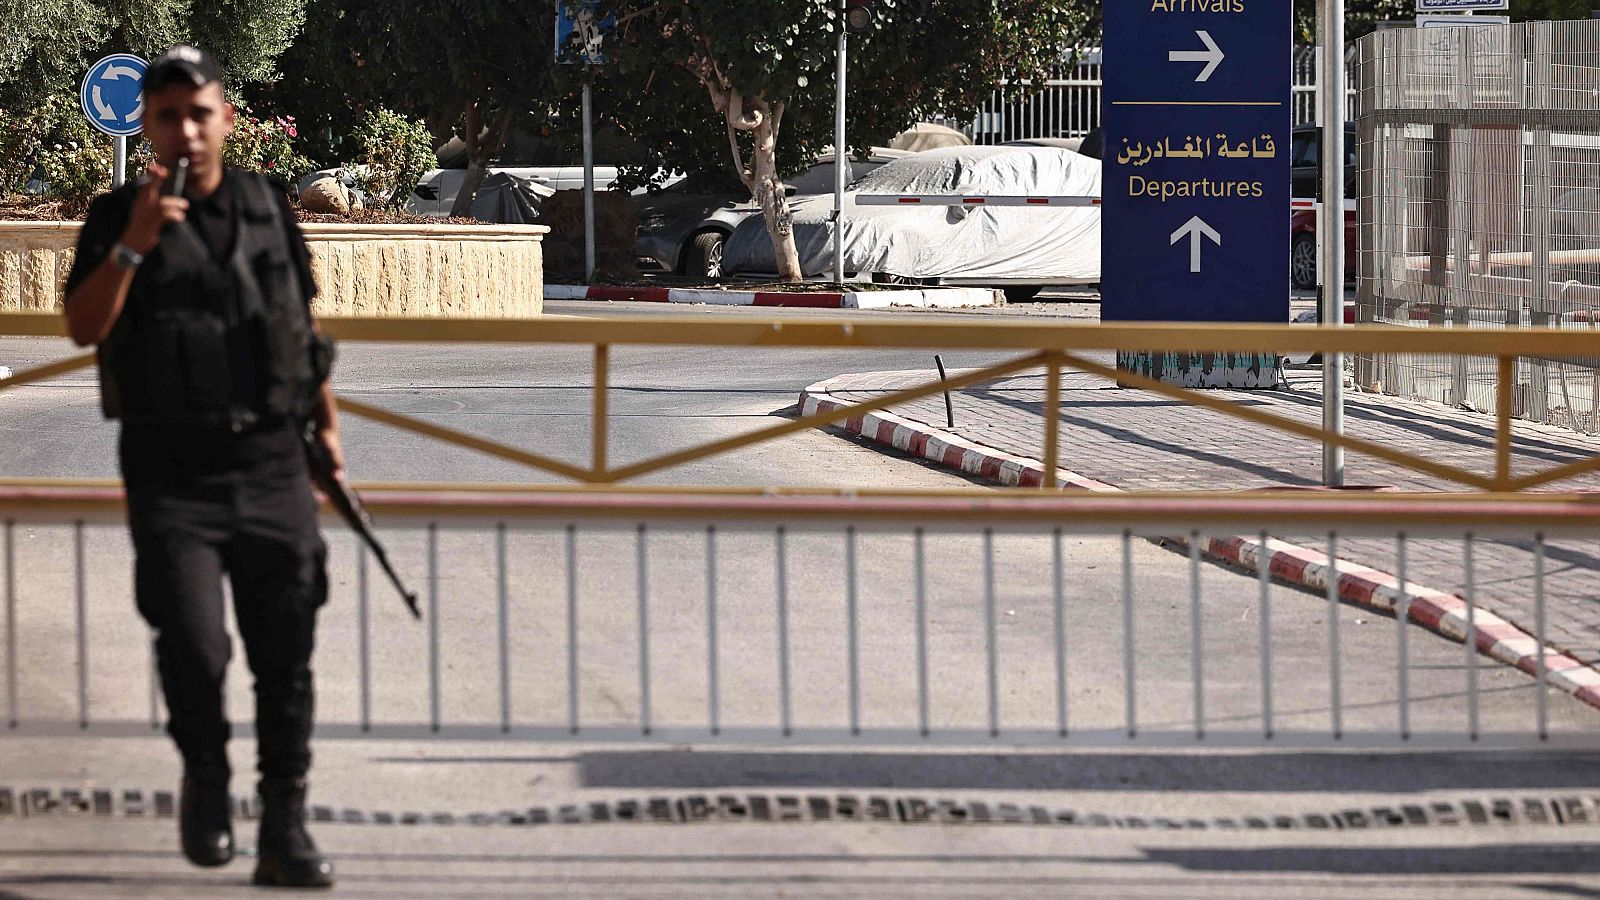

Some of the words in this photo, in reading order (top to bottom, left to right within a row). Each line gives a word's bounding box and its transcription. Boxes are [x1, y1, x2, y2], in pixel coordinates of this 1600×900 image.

[1151, 0, 1244, 12] Arrivals
[1117, 135, 1211, 166] المغادرين
[1216, 133, 1276, 158] قاعة
[1129, 175, 1263, 202] Departures
